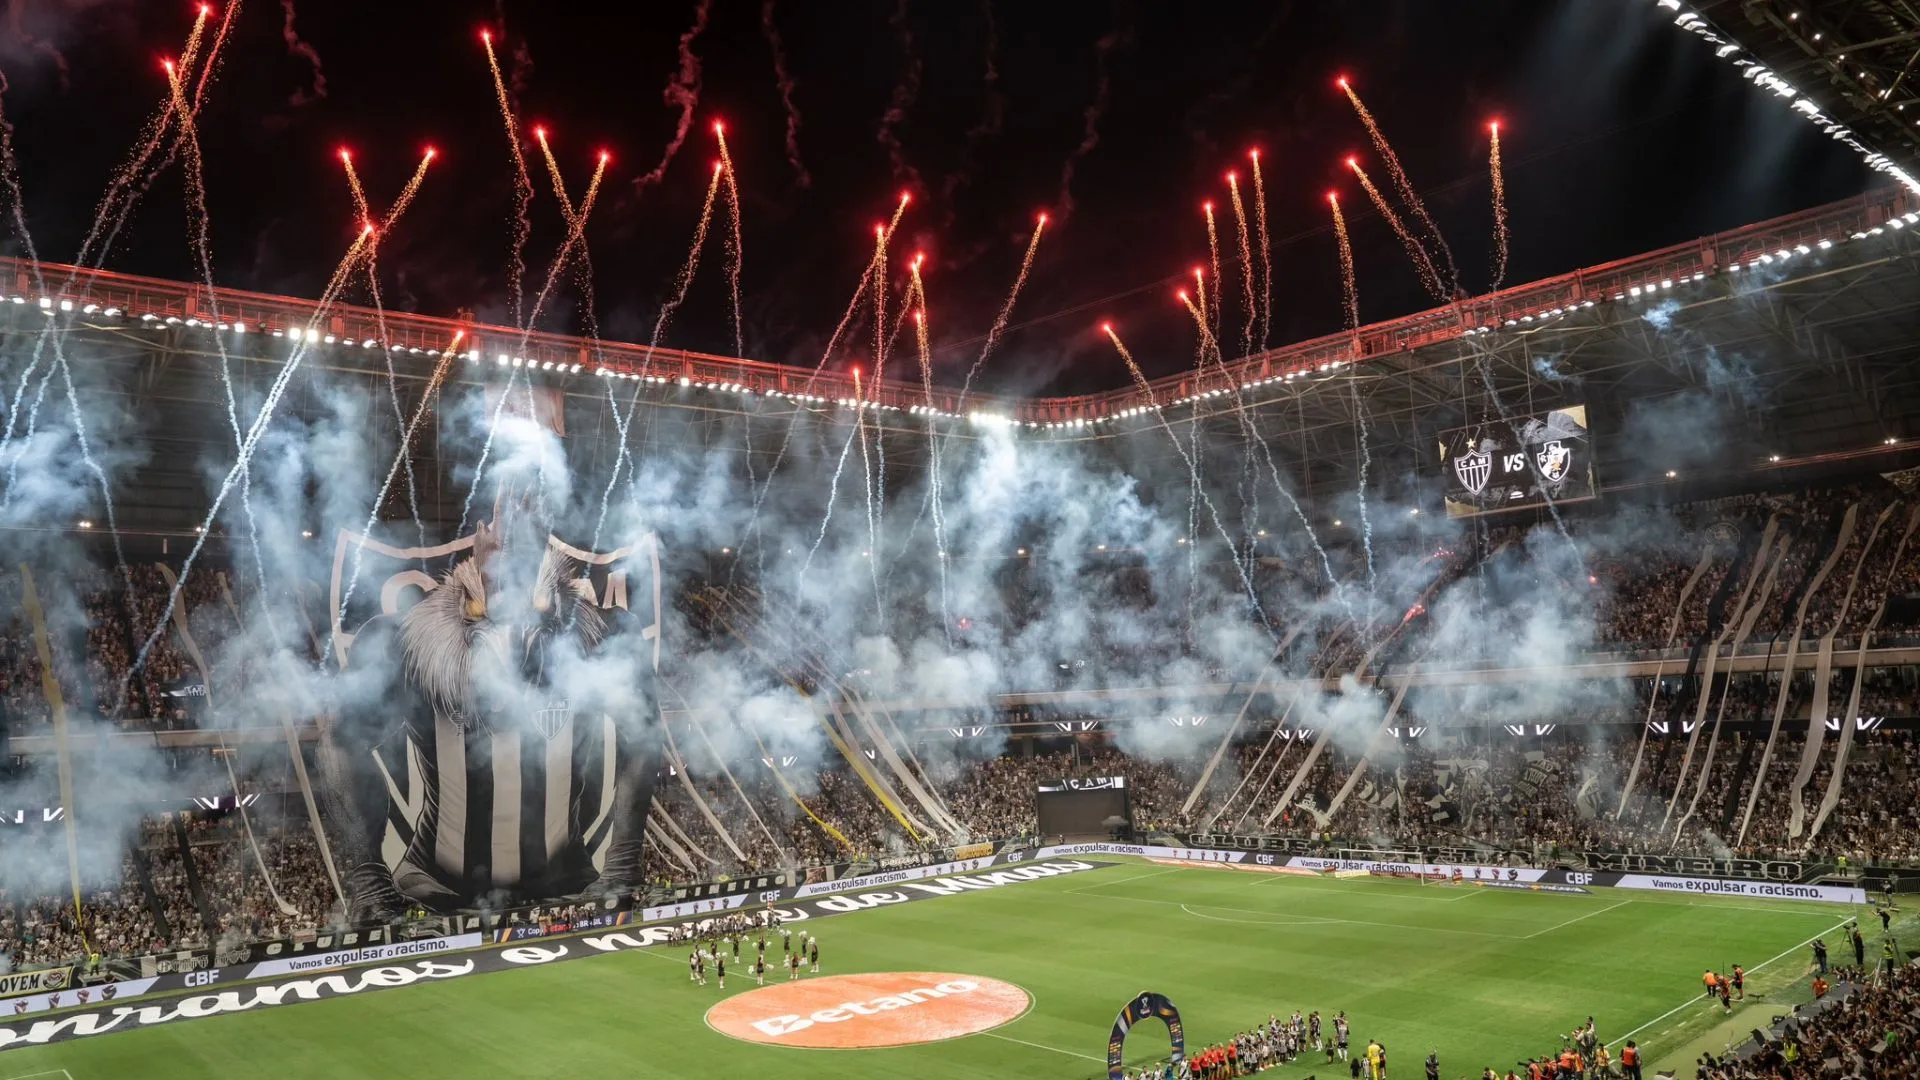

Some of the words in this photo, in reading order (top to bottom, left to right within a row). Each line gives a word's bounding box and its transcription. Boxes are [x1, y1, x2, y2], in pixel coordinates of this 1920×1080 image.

[1504, 453, 1525, 473] VS
[1007, 851, 1023, 863] CBF
[1054, 847, 1073, 855] Vamos
[1073, 842, 1109, 854] expulsar
[1115, 845, 1145, 855] racismo.
[1256, 854, 1274, 865] CBF
[1301, 859, 1322, 868] Vamos
[809, 885, 831, 894] Vamos
[830, 876, 869, 891] expulsar
[874, 870, 910, 883] racismo.
[815, 889, 909, 911] de
[903, 859, 1094, 895] Minas
[1565, 871, 1593, 885] CBF
[759, 889, 782, 903] CBF
[1652, 879, 1684, 890] Vamos
[1685, 880, 1747, 894] expulsar
[1750, 886, 1757, 894] o
[1758, 883, 1823, 899] racismo.
[289, 957, 323, 971] Vamos
[324, 948, 385, 967] expulsar
[387, 949, 394, 957] o
[395, 939, 450, 956] racismo.
[184, 969, 220, 988] CBF
[752, 980, 980, 1037] Betano
